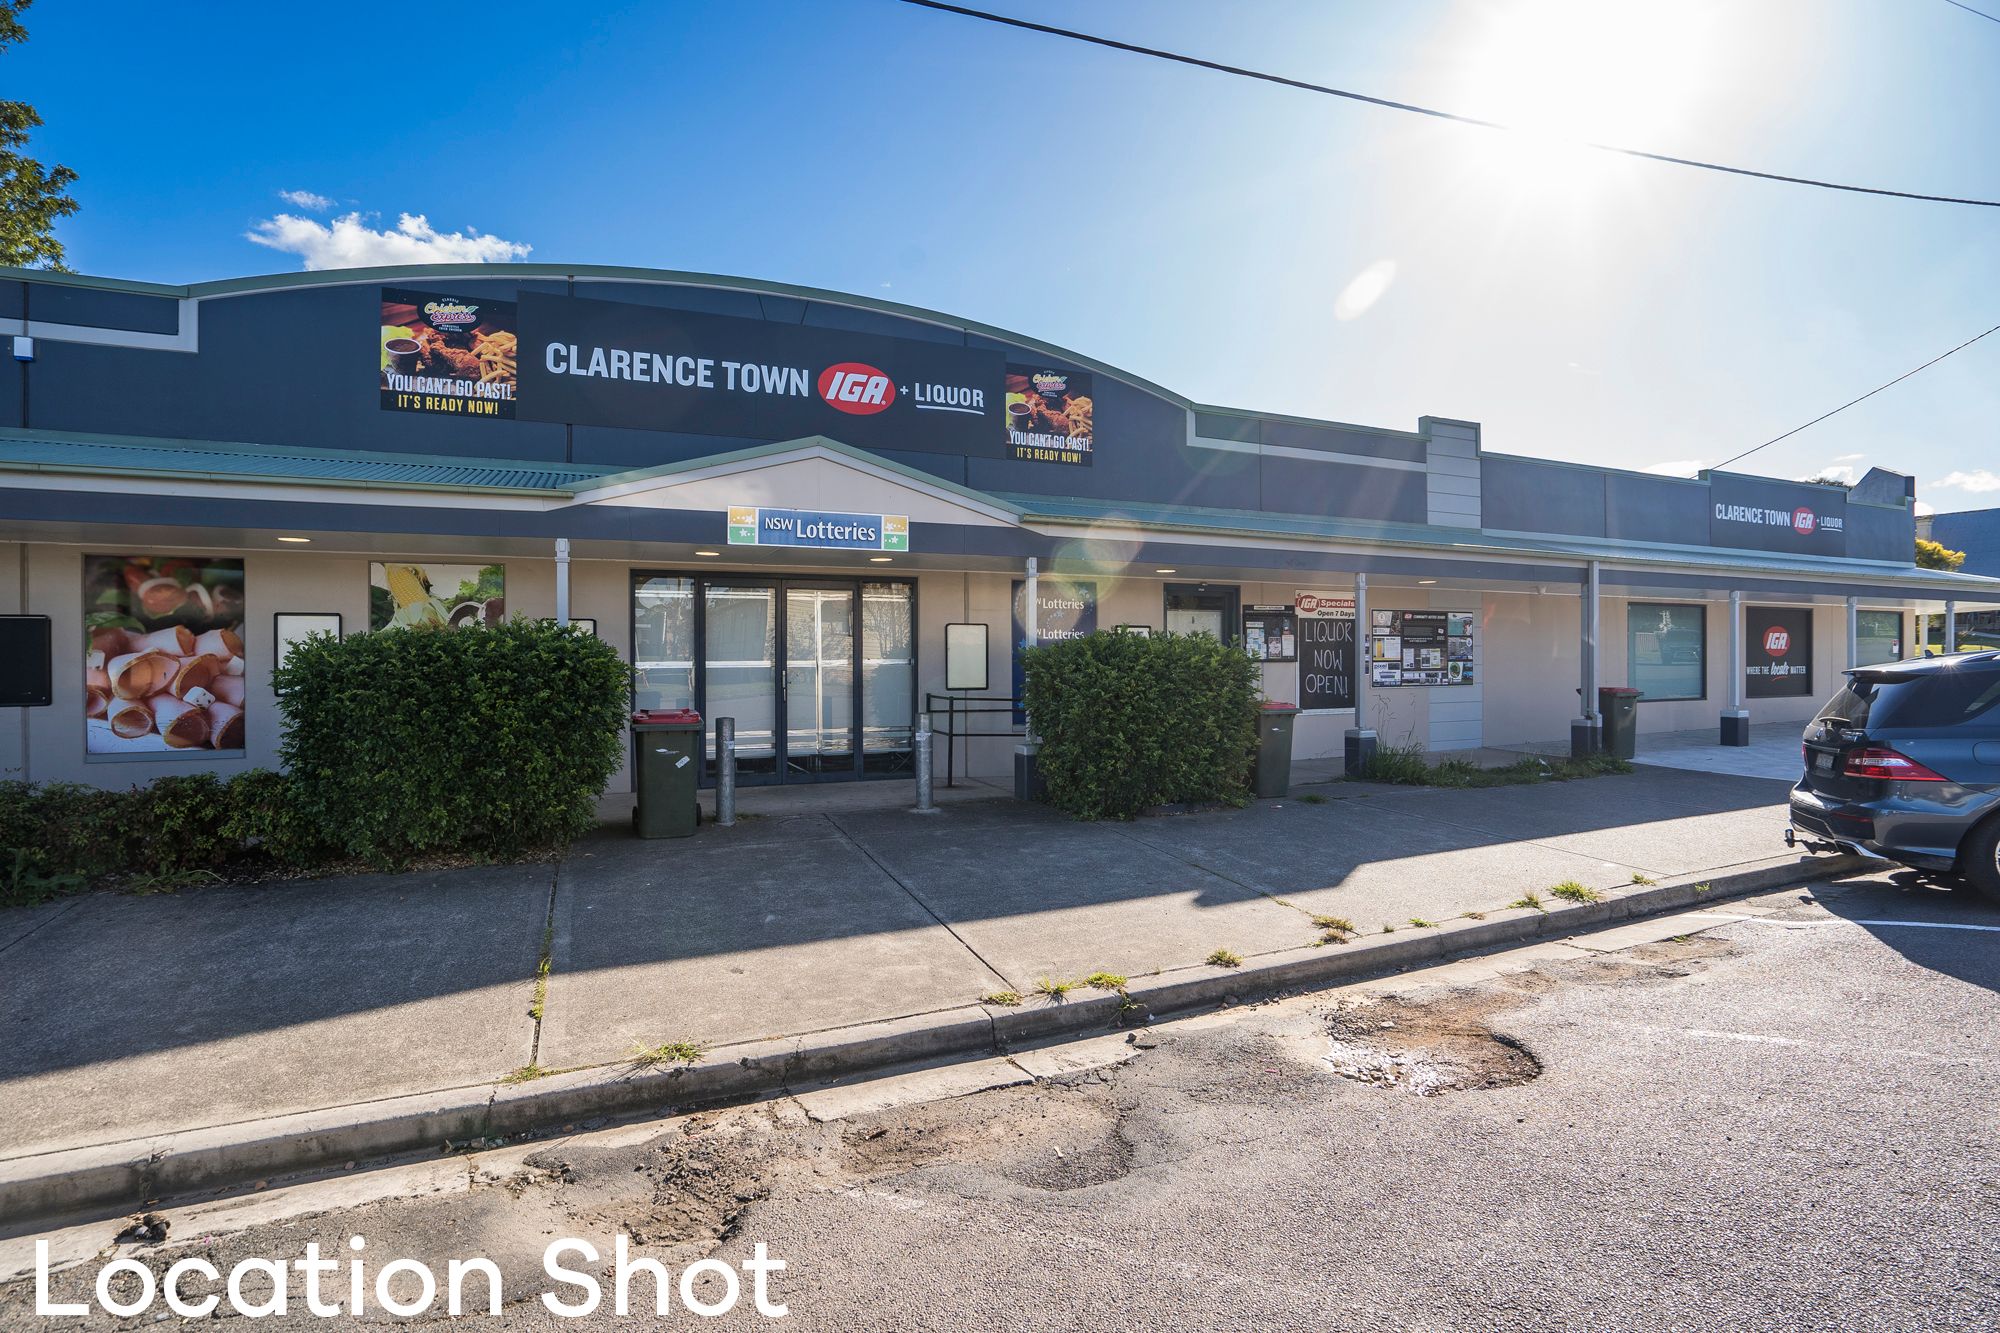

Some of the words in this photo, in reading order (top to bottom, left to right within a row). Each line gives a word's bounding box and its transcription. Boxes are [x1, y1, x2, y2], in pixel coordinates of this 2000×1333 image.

[546, 342, 714, 388] CLARENCE
[721, 361, 809, 397] TOWN
[826, 371, 888, 405] IGA
[915, 383, 984, 408] LIQUOR
[386, 373, 413, 393] YOU
[416, 376, 452, 396] CAN'T
[456, 379, 473, 397] GO
[476, 381, 511, 400] PAST!
[398, 394, 420, 409] IT'S
[426, 396, 464, 413] READY
[468, 400, 499, 415] NOW!
[1009, 430, 1026, 445] YOU
[1028, 432, 1052, 448] CAN'T
[1053, 435, 1065, 449] GO
[1067, 437, 1089, 452] PAST!
[1016, 447, 1032, 459] IT'S
[1034, 449, 1059, 461] READY
[1061, 451, 1081, 463] NOW!
[1715, 503, 1763, 524] CLARENCE
[1764, 509, 1790, 527] TOWN
[1794, 512, 1814, 529] IGA
[1820, 516, 1843, 528] LIQUOR
[765, 517, 794, 531] NSW
[796, 519, 876, 541] Lotteries
[1042, 598, 1085, 610] Lotteries
[1300, 598, 1318, 609] IGA
[1320, 600, 1355, 608] Specials
[1317, 610, 1334, 618] Open
[1042, 628, 1085, 640] Lotteries
[1305, 621, 1353, 642] LIQUOR
[1765, 632, 1787, 650] IGA
[1314, 649, 1343, 671] NOW
[1305, 673, 1348, 698] OPEN!
